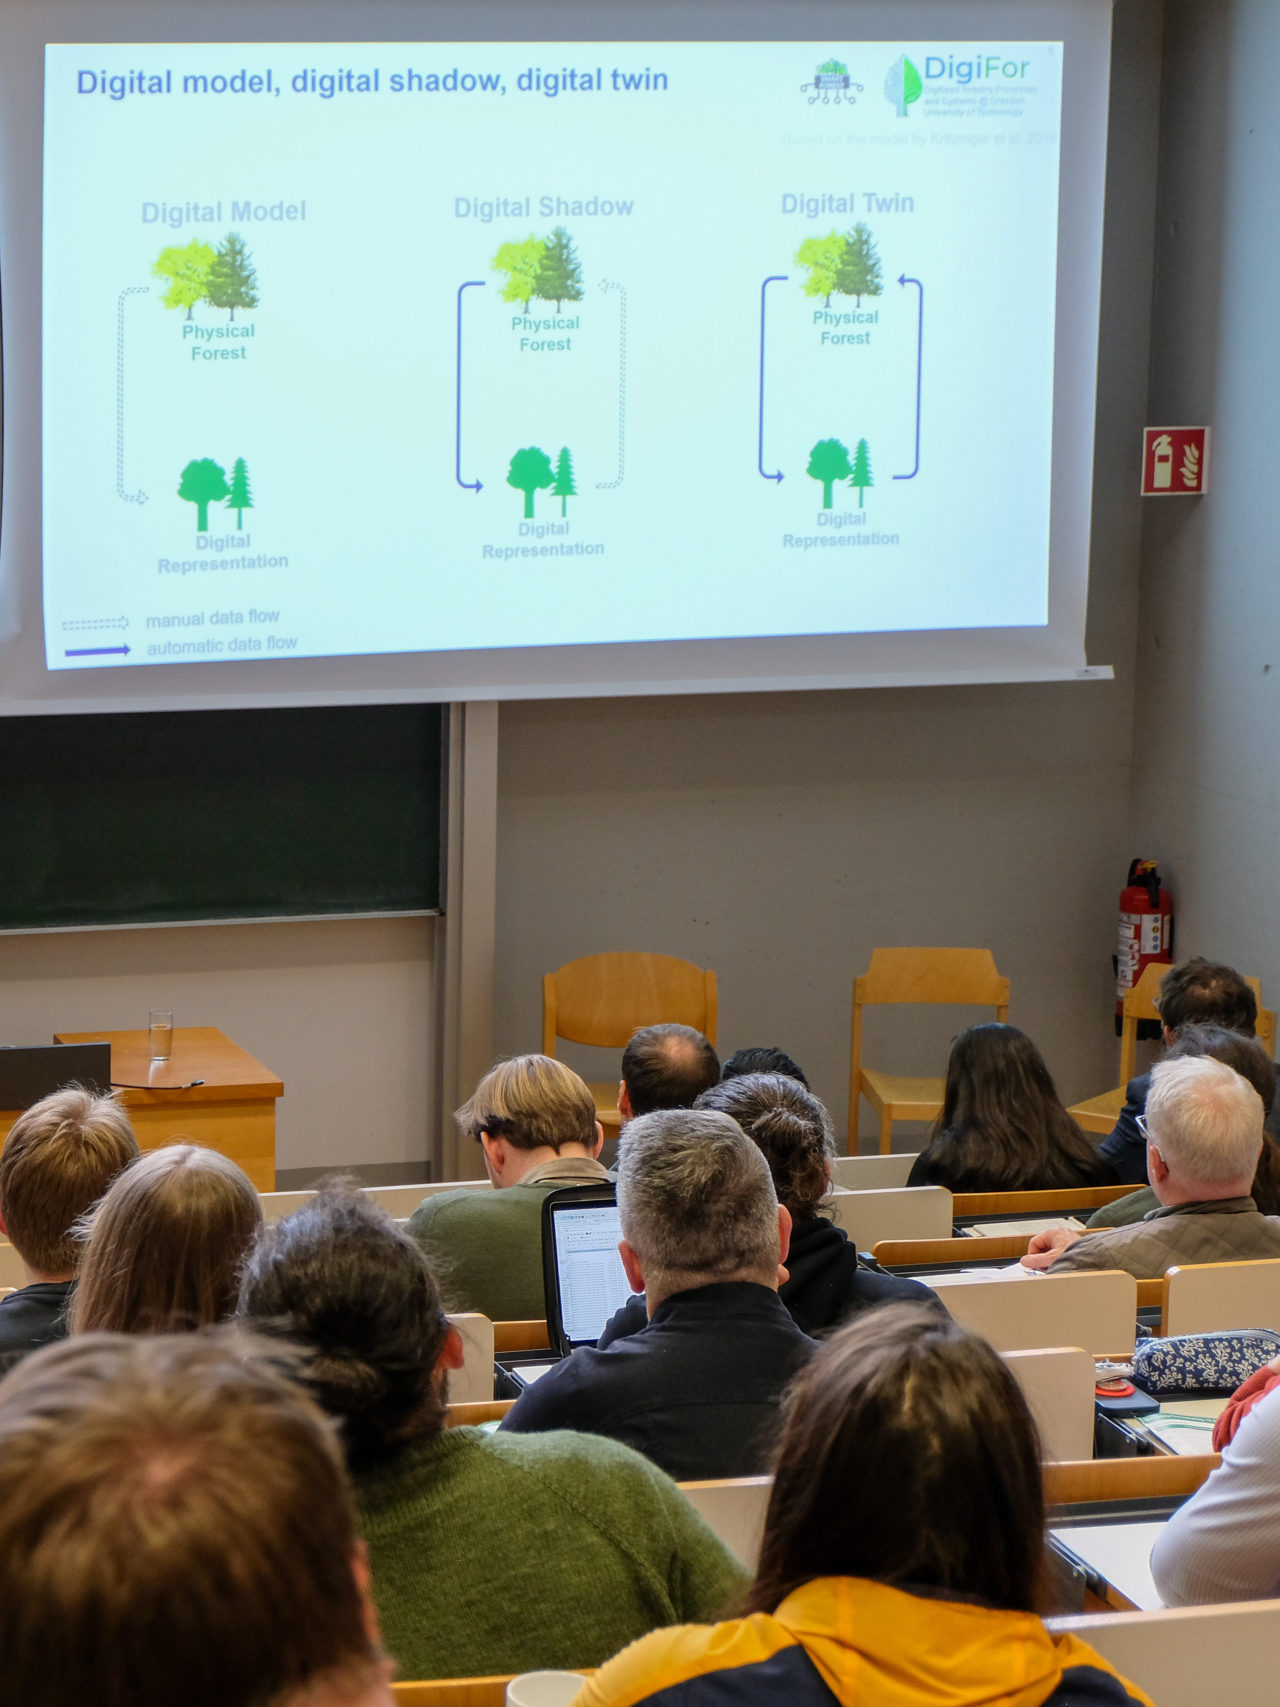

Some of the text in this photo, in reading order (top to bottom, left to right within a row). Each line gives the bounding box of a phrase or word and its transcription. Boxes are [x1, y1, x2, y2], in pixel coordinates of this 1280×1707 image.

[925, 55, 1031, 85] DigiFor
[77, 67, 669, 101] Digital model, digital shadow, digital twin
[141, 199, 307, 229] Digital Model
[454, 196, 635, 224] Digital Shadow
[781, 192, 915, 220] Digital Twin
[511, 315, 580, 335] Physical
[813, 310, 879, 328] Physical
[182, 323, 255, 344] Physical
[820, 331, 871, 345] Forest
[191, 345, 247, 361] Forest
[520, 337, 572, 352] Forest
[518, 521, 570, 540] Digital
[817, 511, 867, 530] Digital
[195, 533, 251, 553] Digital
[482, 541, 605, 562] Representation
[783, 531, 900, 551] Representation
[157, 553, 289, 576] Representation
[145, 608, 281, 629] manual data flow
[147, 634, 299, 656] automatic data flow
